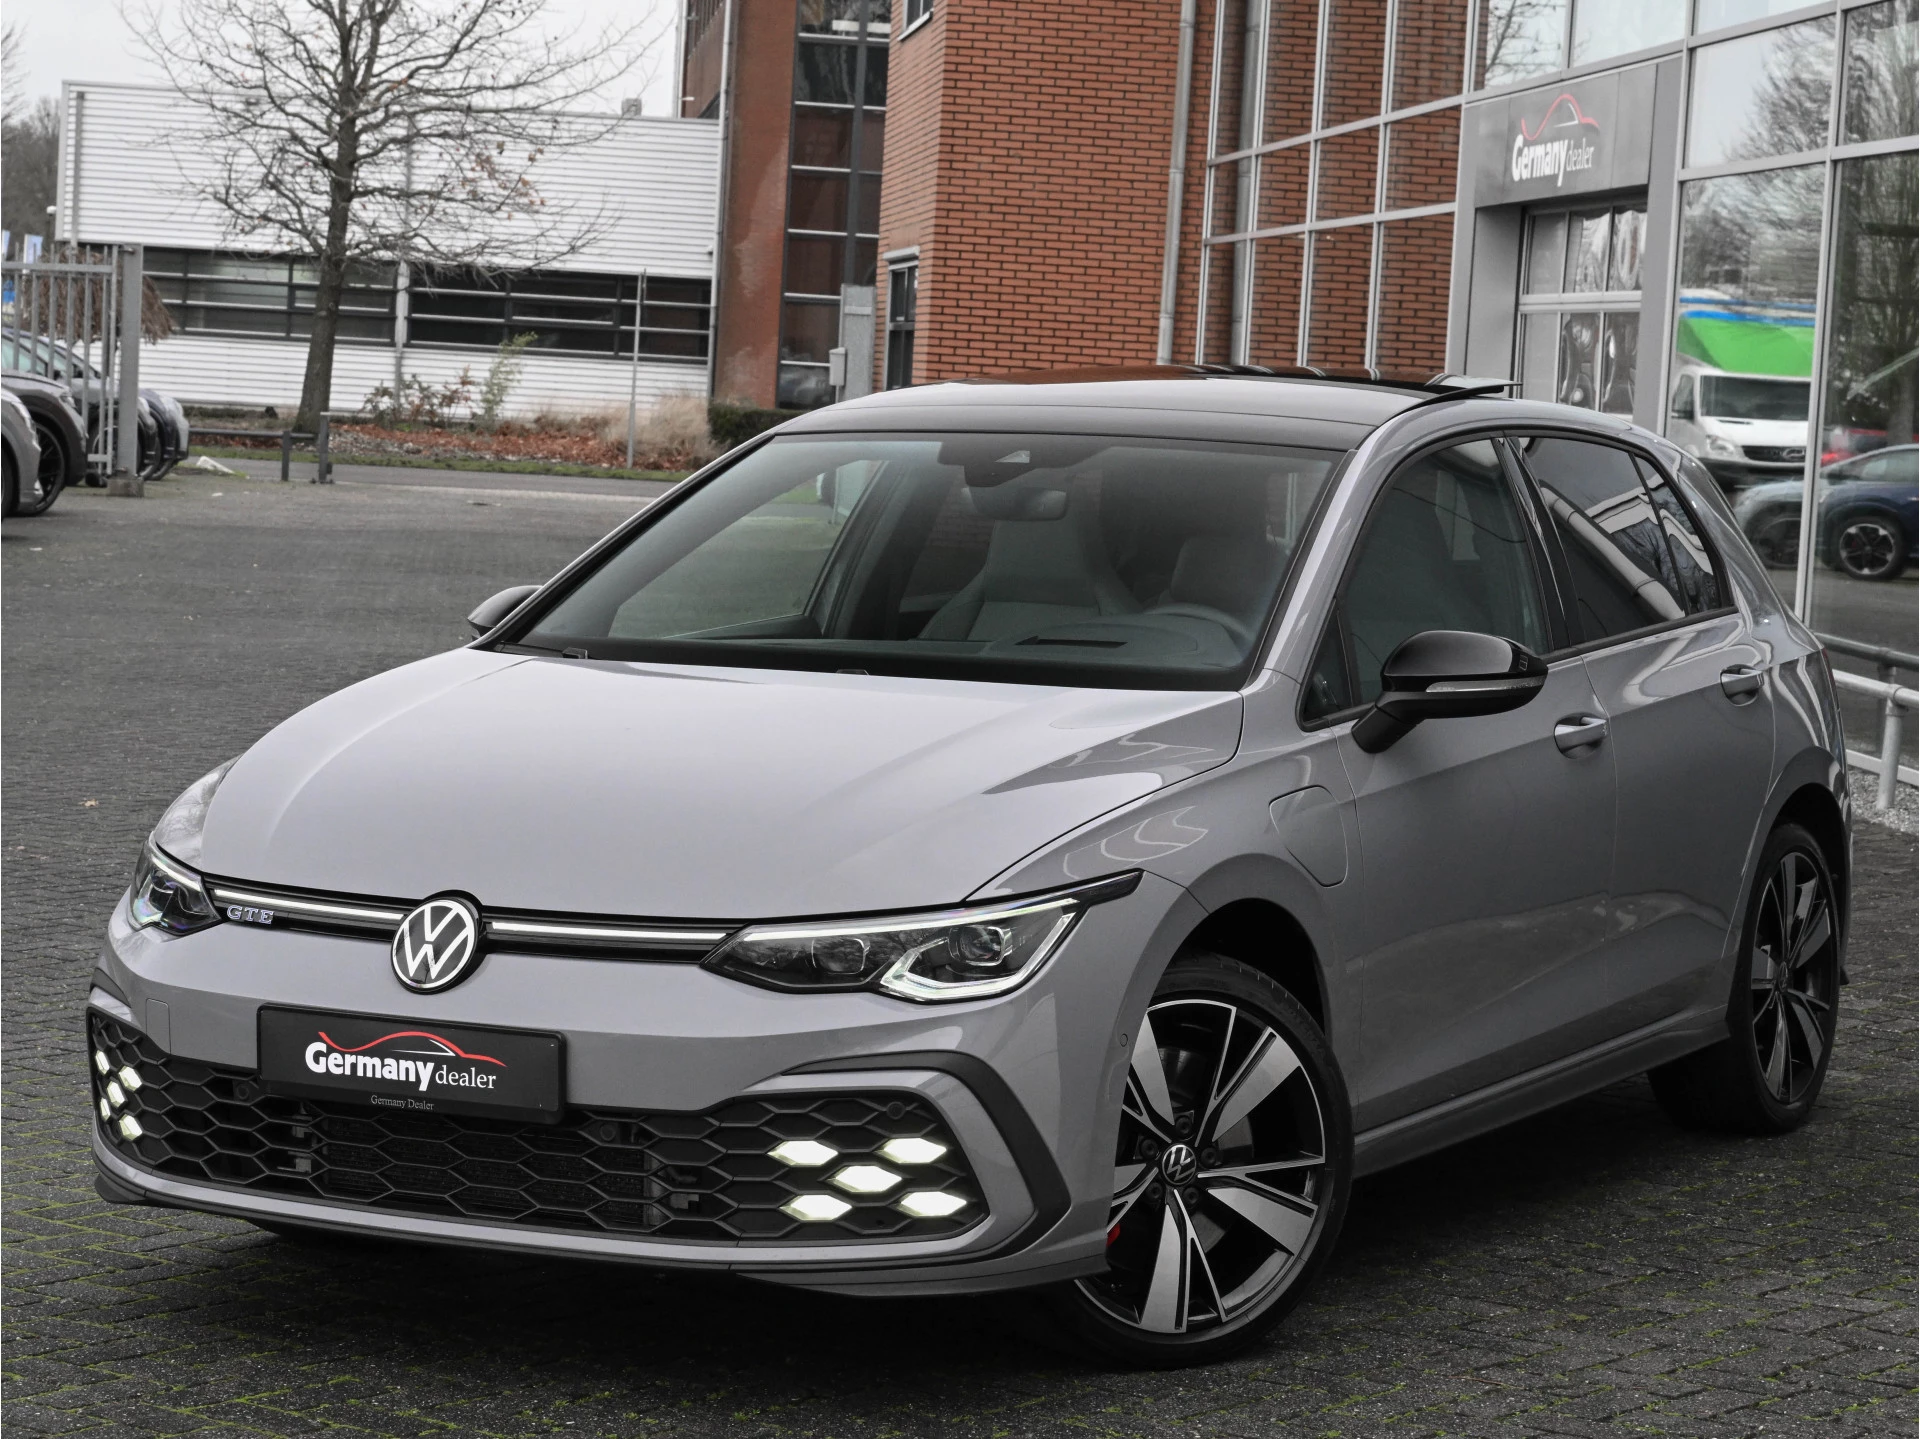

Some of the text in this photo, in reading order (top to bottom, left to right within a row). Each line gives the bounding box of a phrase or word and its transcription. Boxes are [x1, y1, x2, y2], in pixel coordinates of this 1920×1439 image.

[1512, 133, 1595, 187] Germany dealer
[226, 905, 275, 925] GTE
[399, 901, 473, 983] VW
[305, 1041, 497, 1092] Germany dealer
[370, 1094, 435, 1110] Germany Dealer
